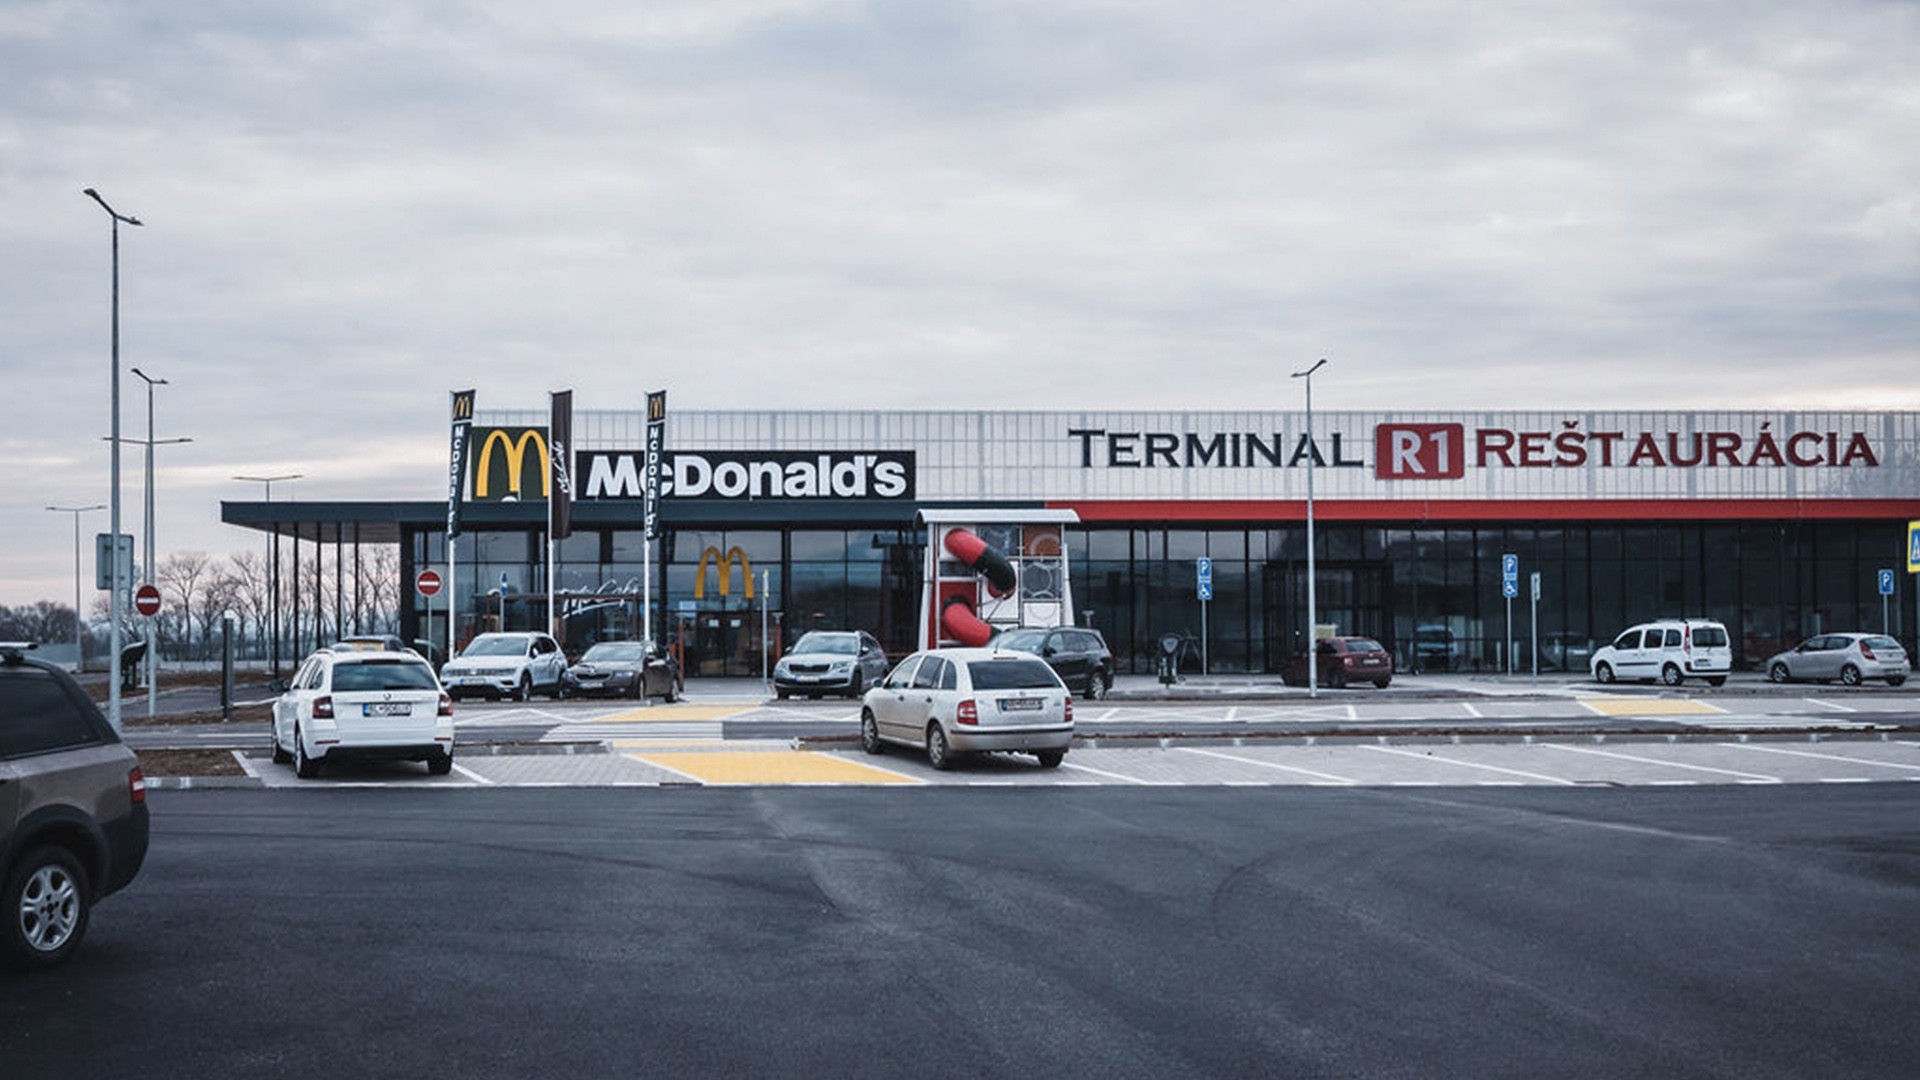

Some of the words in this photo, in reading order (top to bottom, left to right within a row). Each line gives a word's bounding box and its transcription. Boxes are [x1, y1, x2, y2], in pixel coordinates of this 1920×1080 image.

[1068, 428, 1364, 469] TERMINAL
[1391, 430, 1450, 474] R1
[1475, 420, 1880, 468] REŠTAURÁCIA
